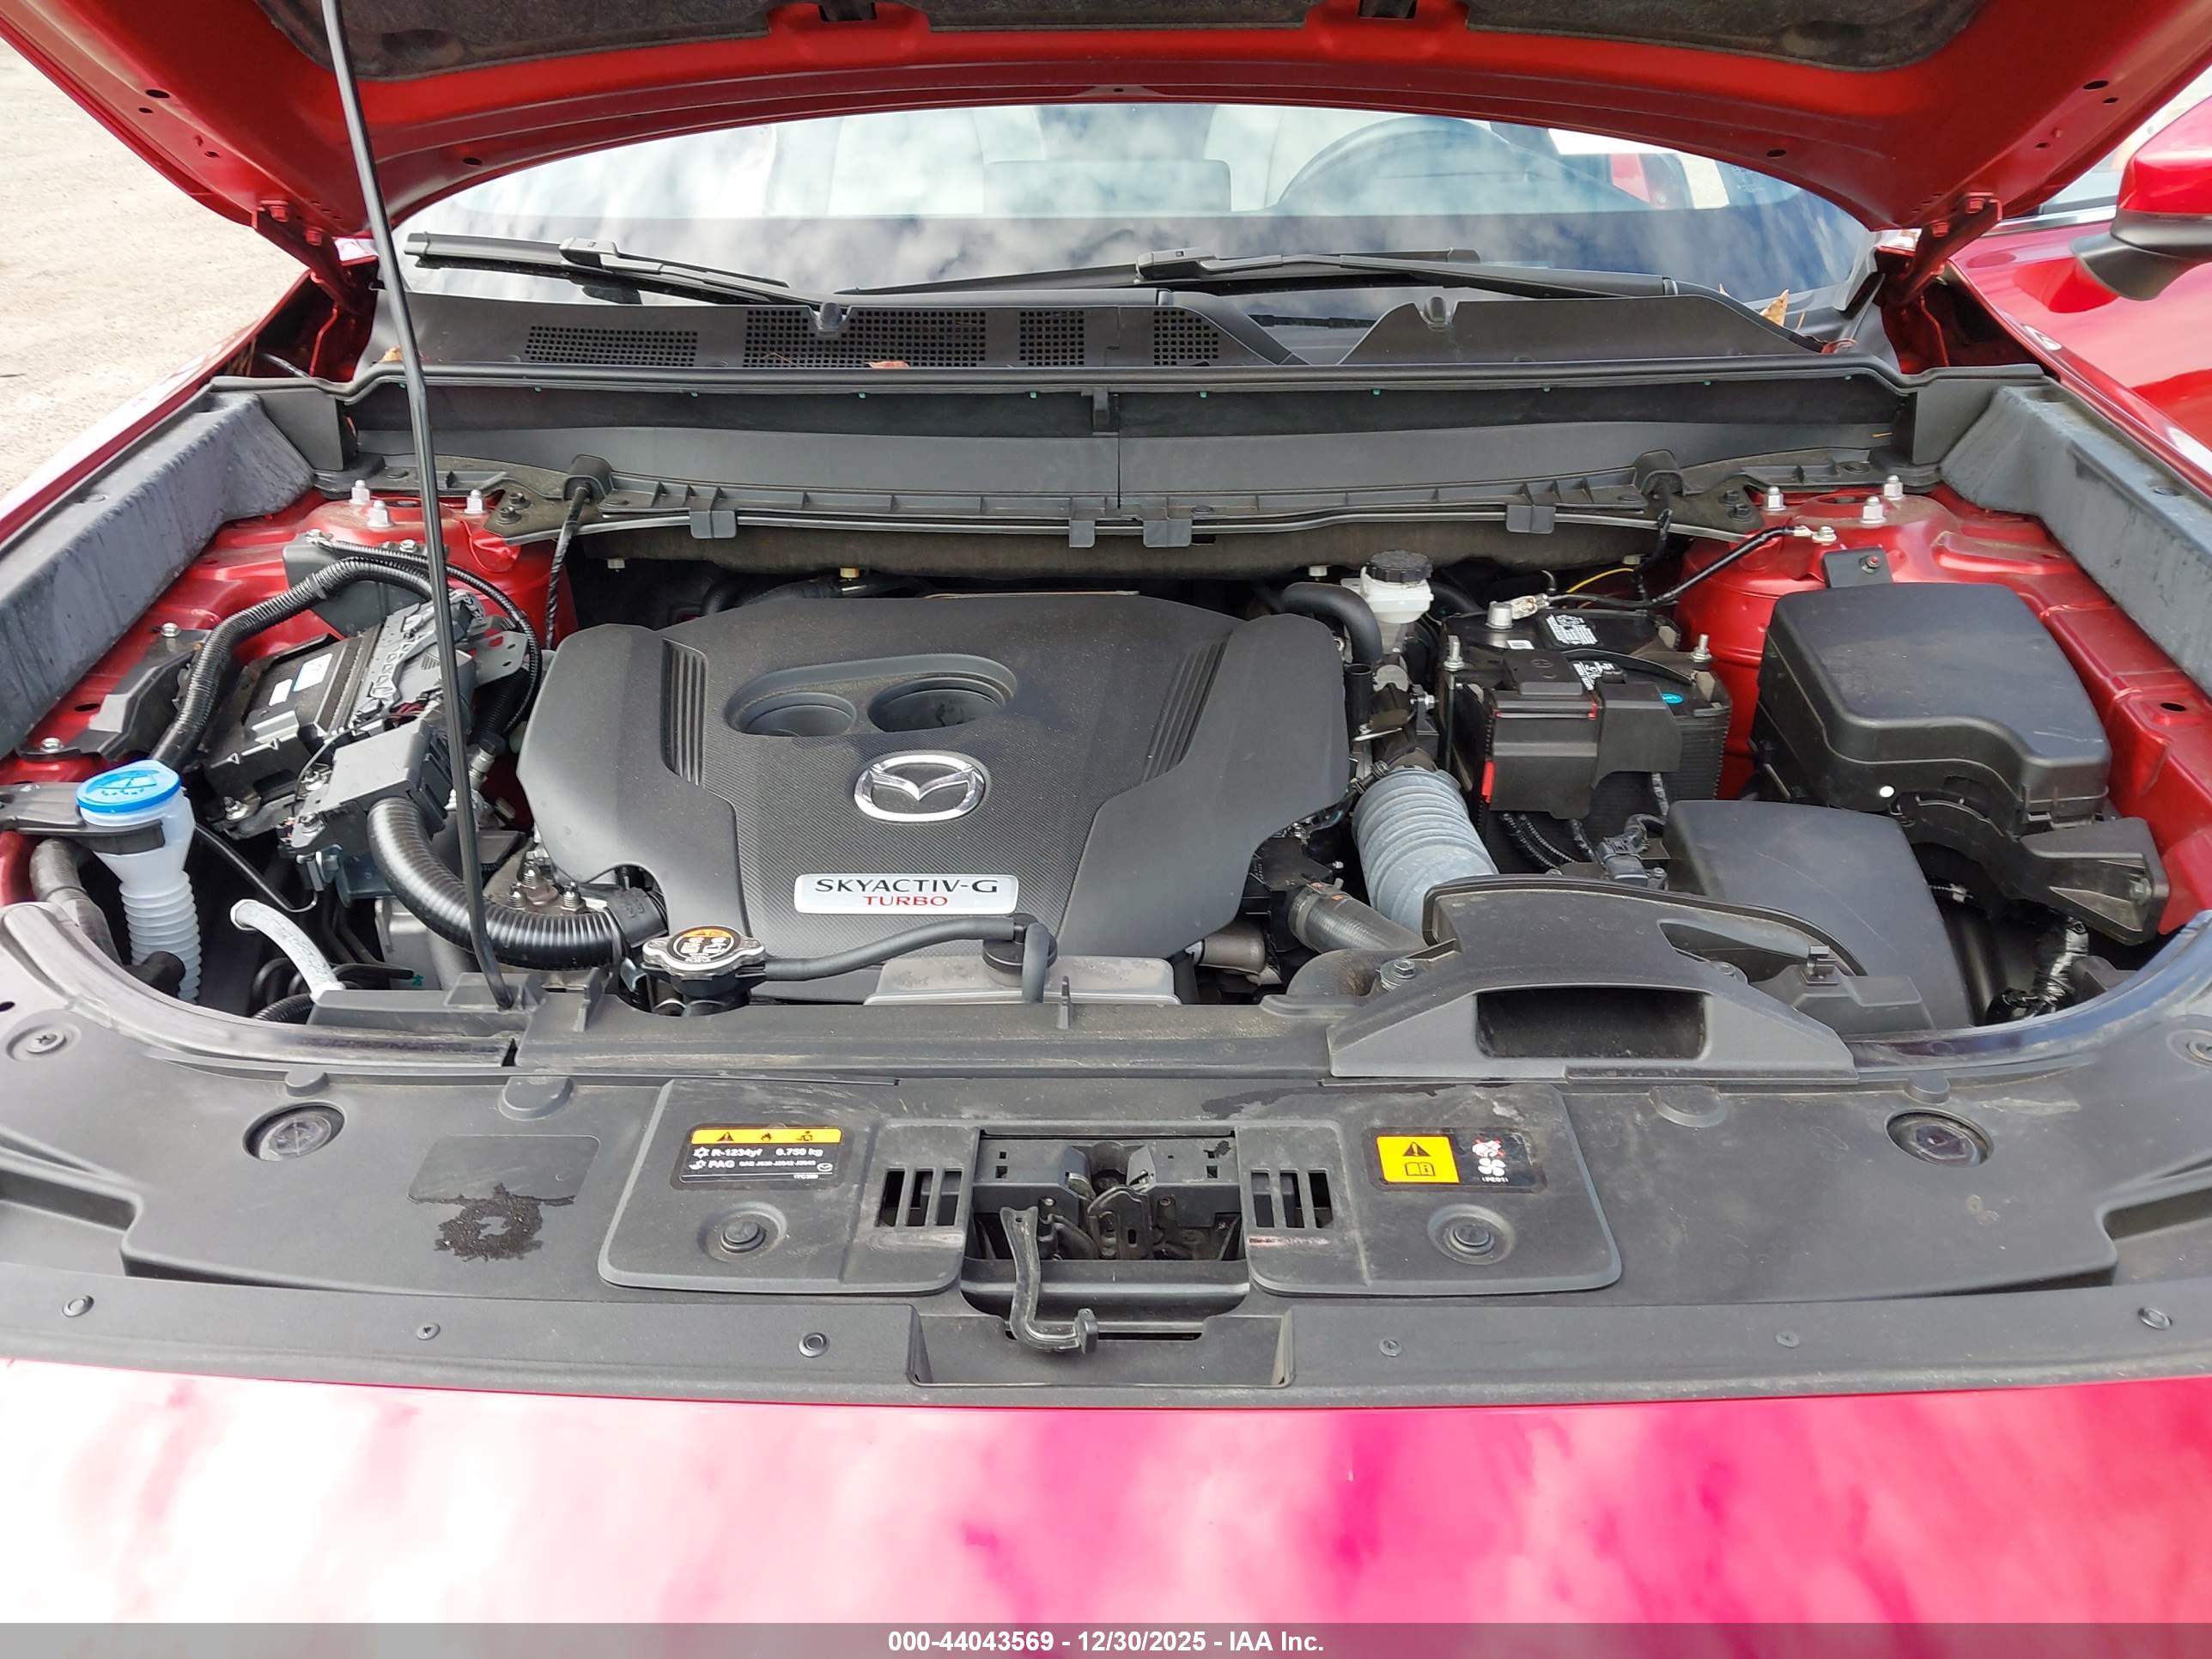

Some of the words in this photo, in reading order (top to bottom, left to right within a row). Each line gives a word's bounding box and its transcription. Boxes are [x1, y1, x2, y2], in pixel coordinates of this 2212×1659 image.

[815, 878, 999, 893] SKYACTIV-G
[862, 896, 948, 907] TURBO
[711, 1148, 763, 1158] R-1234yf
[708, 1160, 735, 1169] PAG
